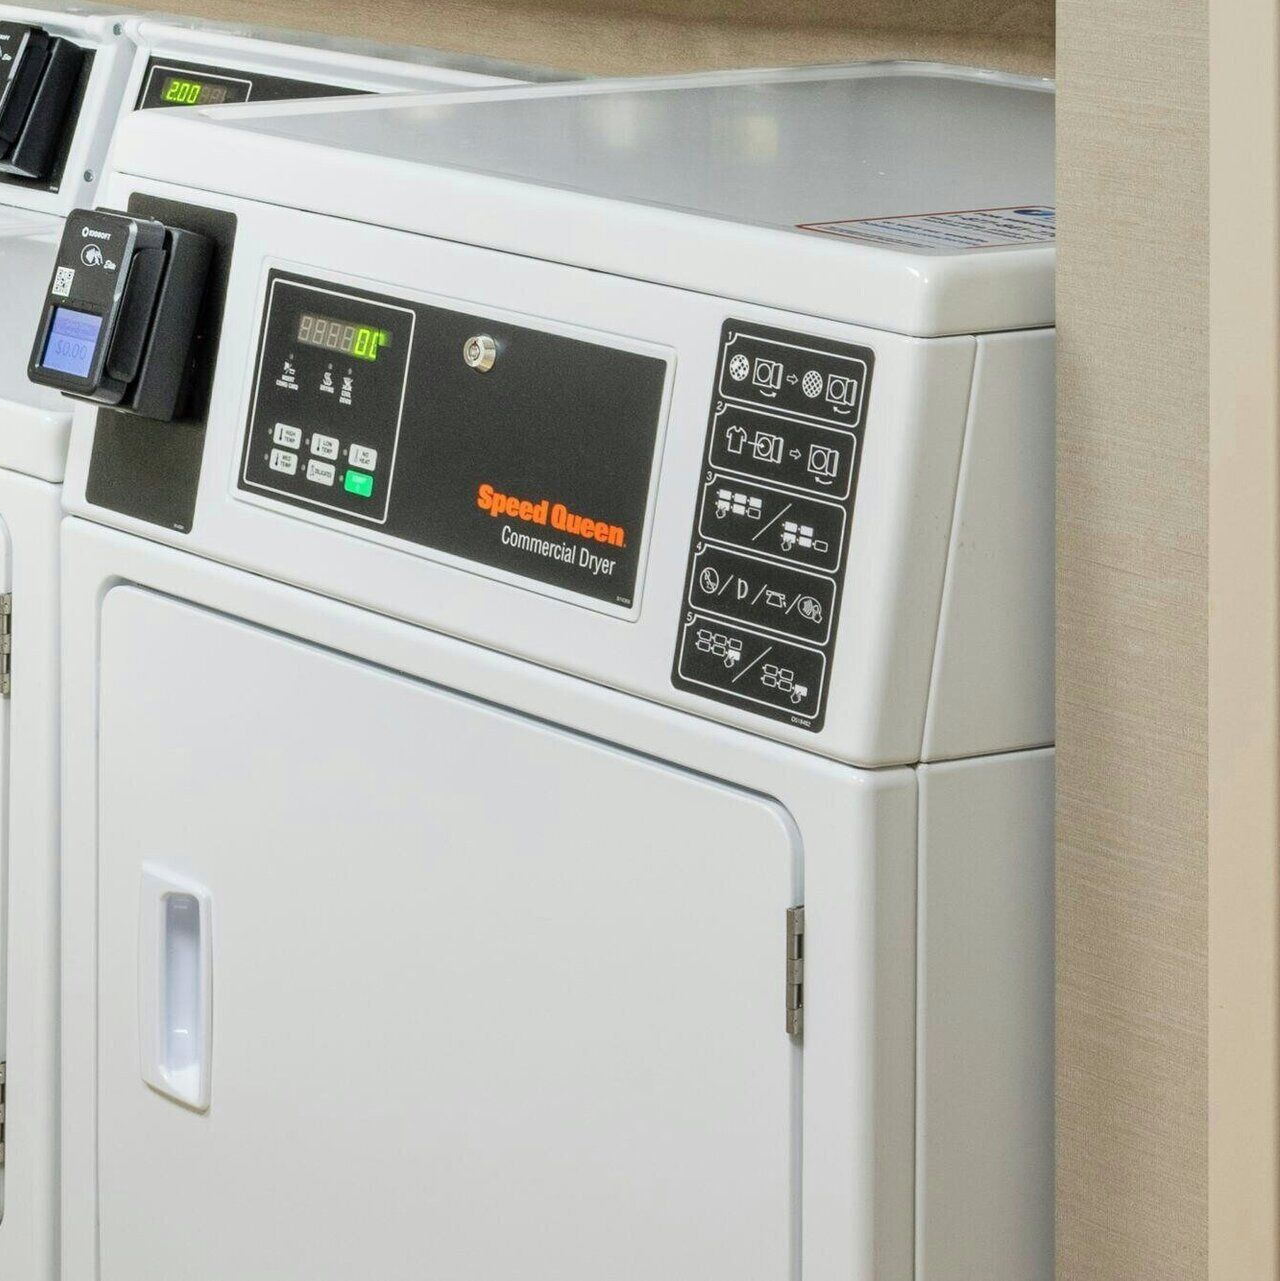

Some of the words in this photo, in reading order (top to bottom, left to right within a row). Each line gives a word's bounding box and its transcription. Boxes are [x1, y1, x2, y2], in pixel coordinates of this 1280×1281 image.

[166, 81, 202, 104] 2.00
[728, 332, 733, 340] 1
[716, 402, 723, 410] 2
[706, 472, 712, 481] 3
[477, 483, 548, 525] Speed
[550, 502, 624, 548] Queen
[502, 525, 576, 565] Commercial
[578, 546, 616, 576] Dryer
[696, 542, 702, 552] 4
[686, 613, 692, 622] 5
